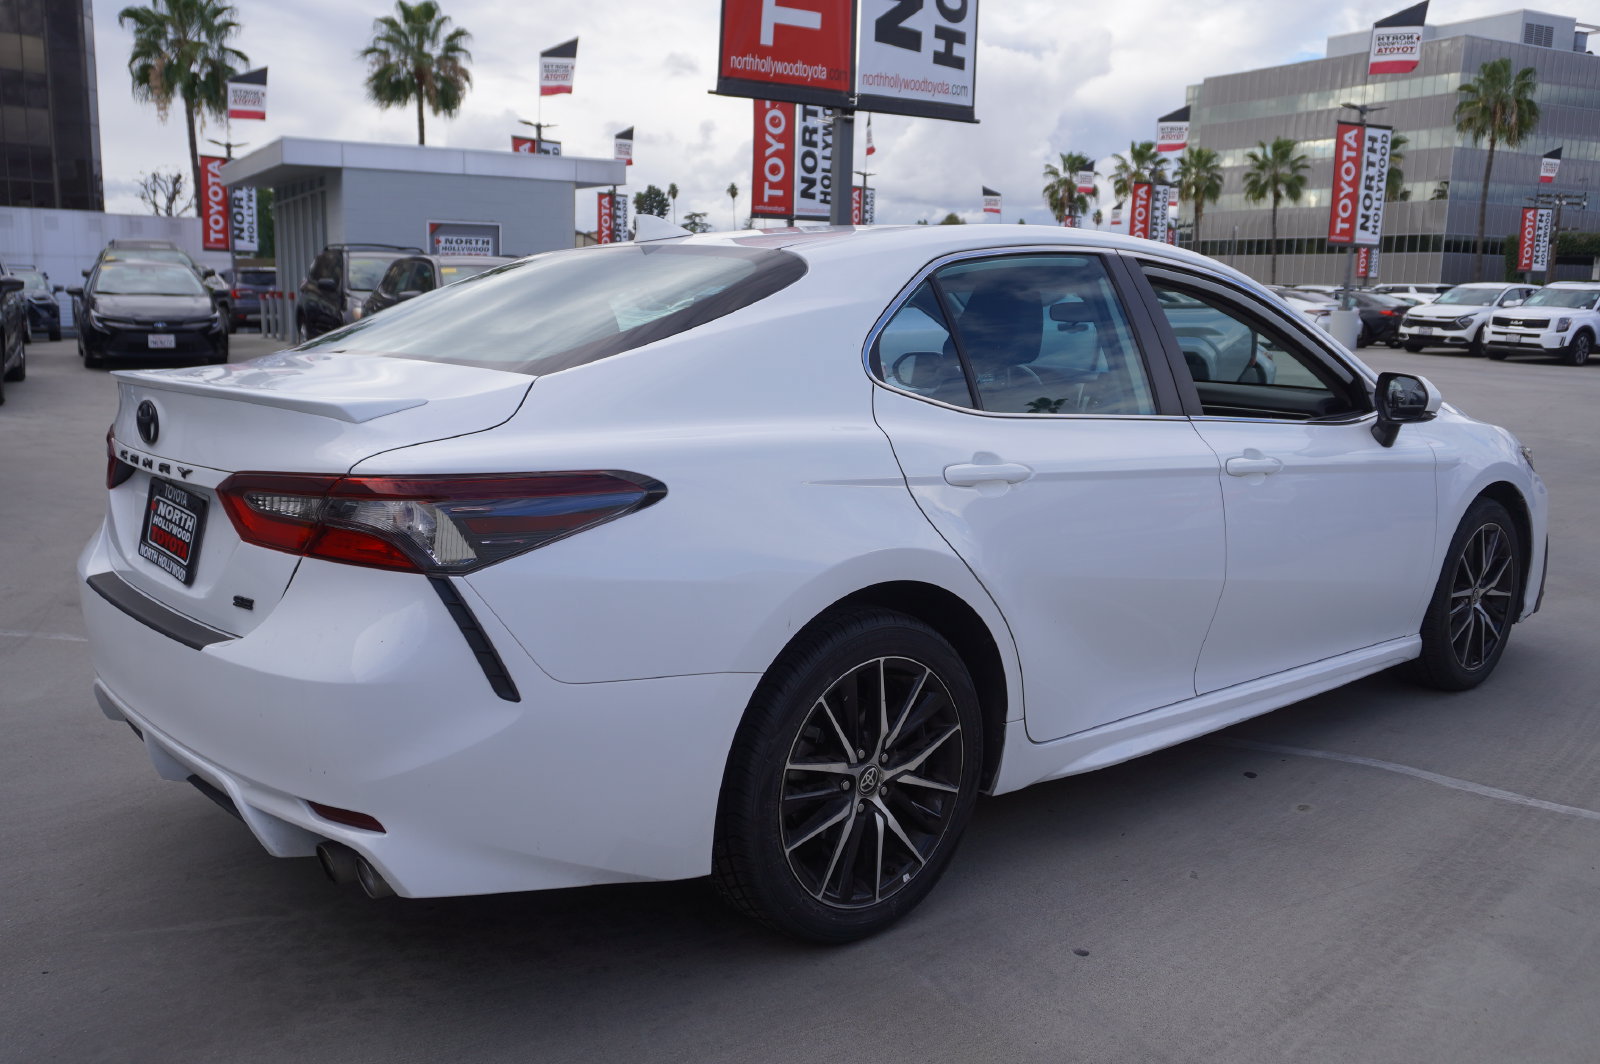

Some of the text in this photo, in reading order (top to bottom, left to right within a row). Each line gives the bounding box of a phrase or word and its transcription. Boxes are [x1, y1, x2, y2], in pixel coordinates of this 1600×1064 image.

[862, 72, 969, 97] northhollywoodtoyota.com
[1335, 129, 1358, 234] TOYOTA
[1359, 135, 1378, 232] NORTH
[1371, 133, 1389, 235] HOLLYWOOD
[207, 160, 224, 242] TOYOTA
[441, 245, 490, 253] HOLLYWOOD
[444, 237, 490, 246] NORTH
[1522, 210, 1535, 266] TOYOTA
[1533, 213, 1544, 264] NORTH
[1540, 212, 1550, 266] HOLLYWOOD
[164, 484, 188, 507] TOYOTA
[152, 514, 191, 543] HOLLYWOOD
[157, 501, 195, 532] NORTH
[151, 525, 188, 560] TOYOTA
[139, 543, 187, 581] NORTH HOLLYWOOD
